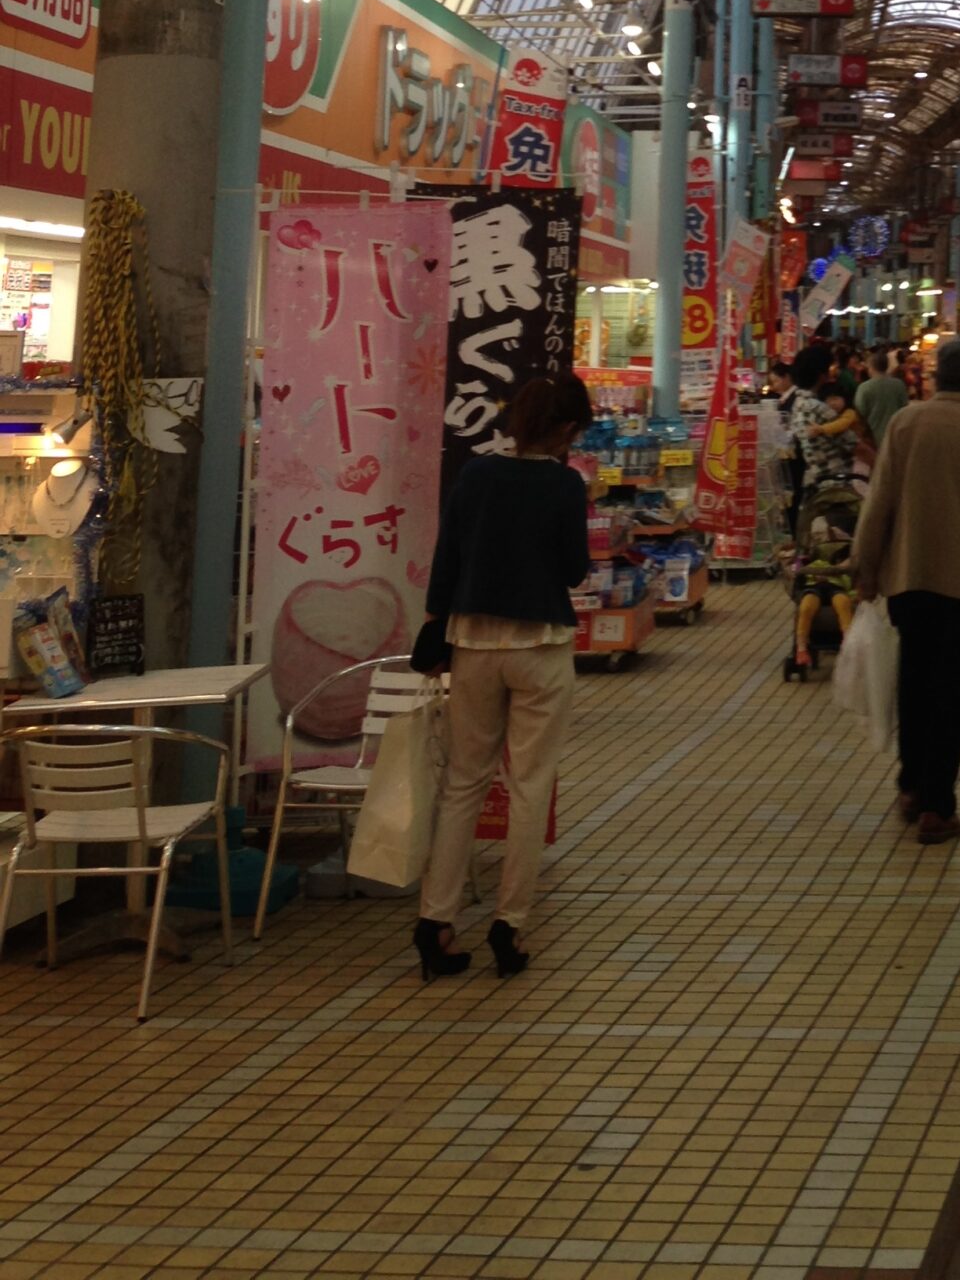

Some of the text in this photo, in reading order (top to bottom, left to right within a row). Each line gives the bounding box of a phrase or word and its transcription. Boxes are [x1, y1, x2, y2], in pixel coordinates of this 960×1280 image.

[738, 76, 749, 88] A
[504, 123, 555, 181] 免
[544, 218, 573, 382] 暗闇でほんのり
[318, 243, 410, 455] ハート
[341, 459, 379, 489] LOVE
[278, 504, 406, 569] ぐらす
